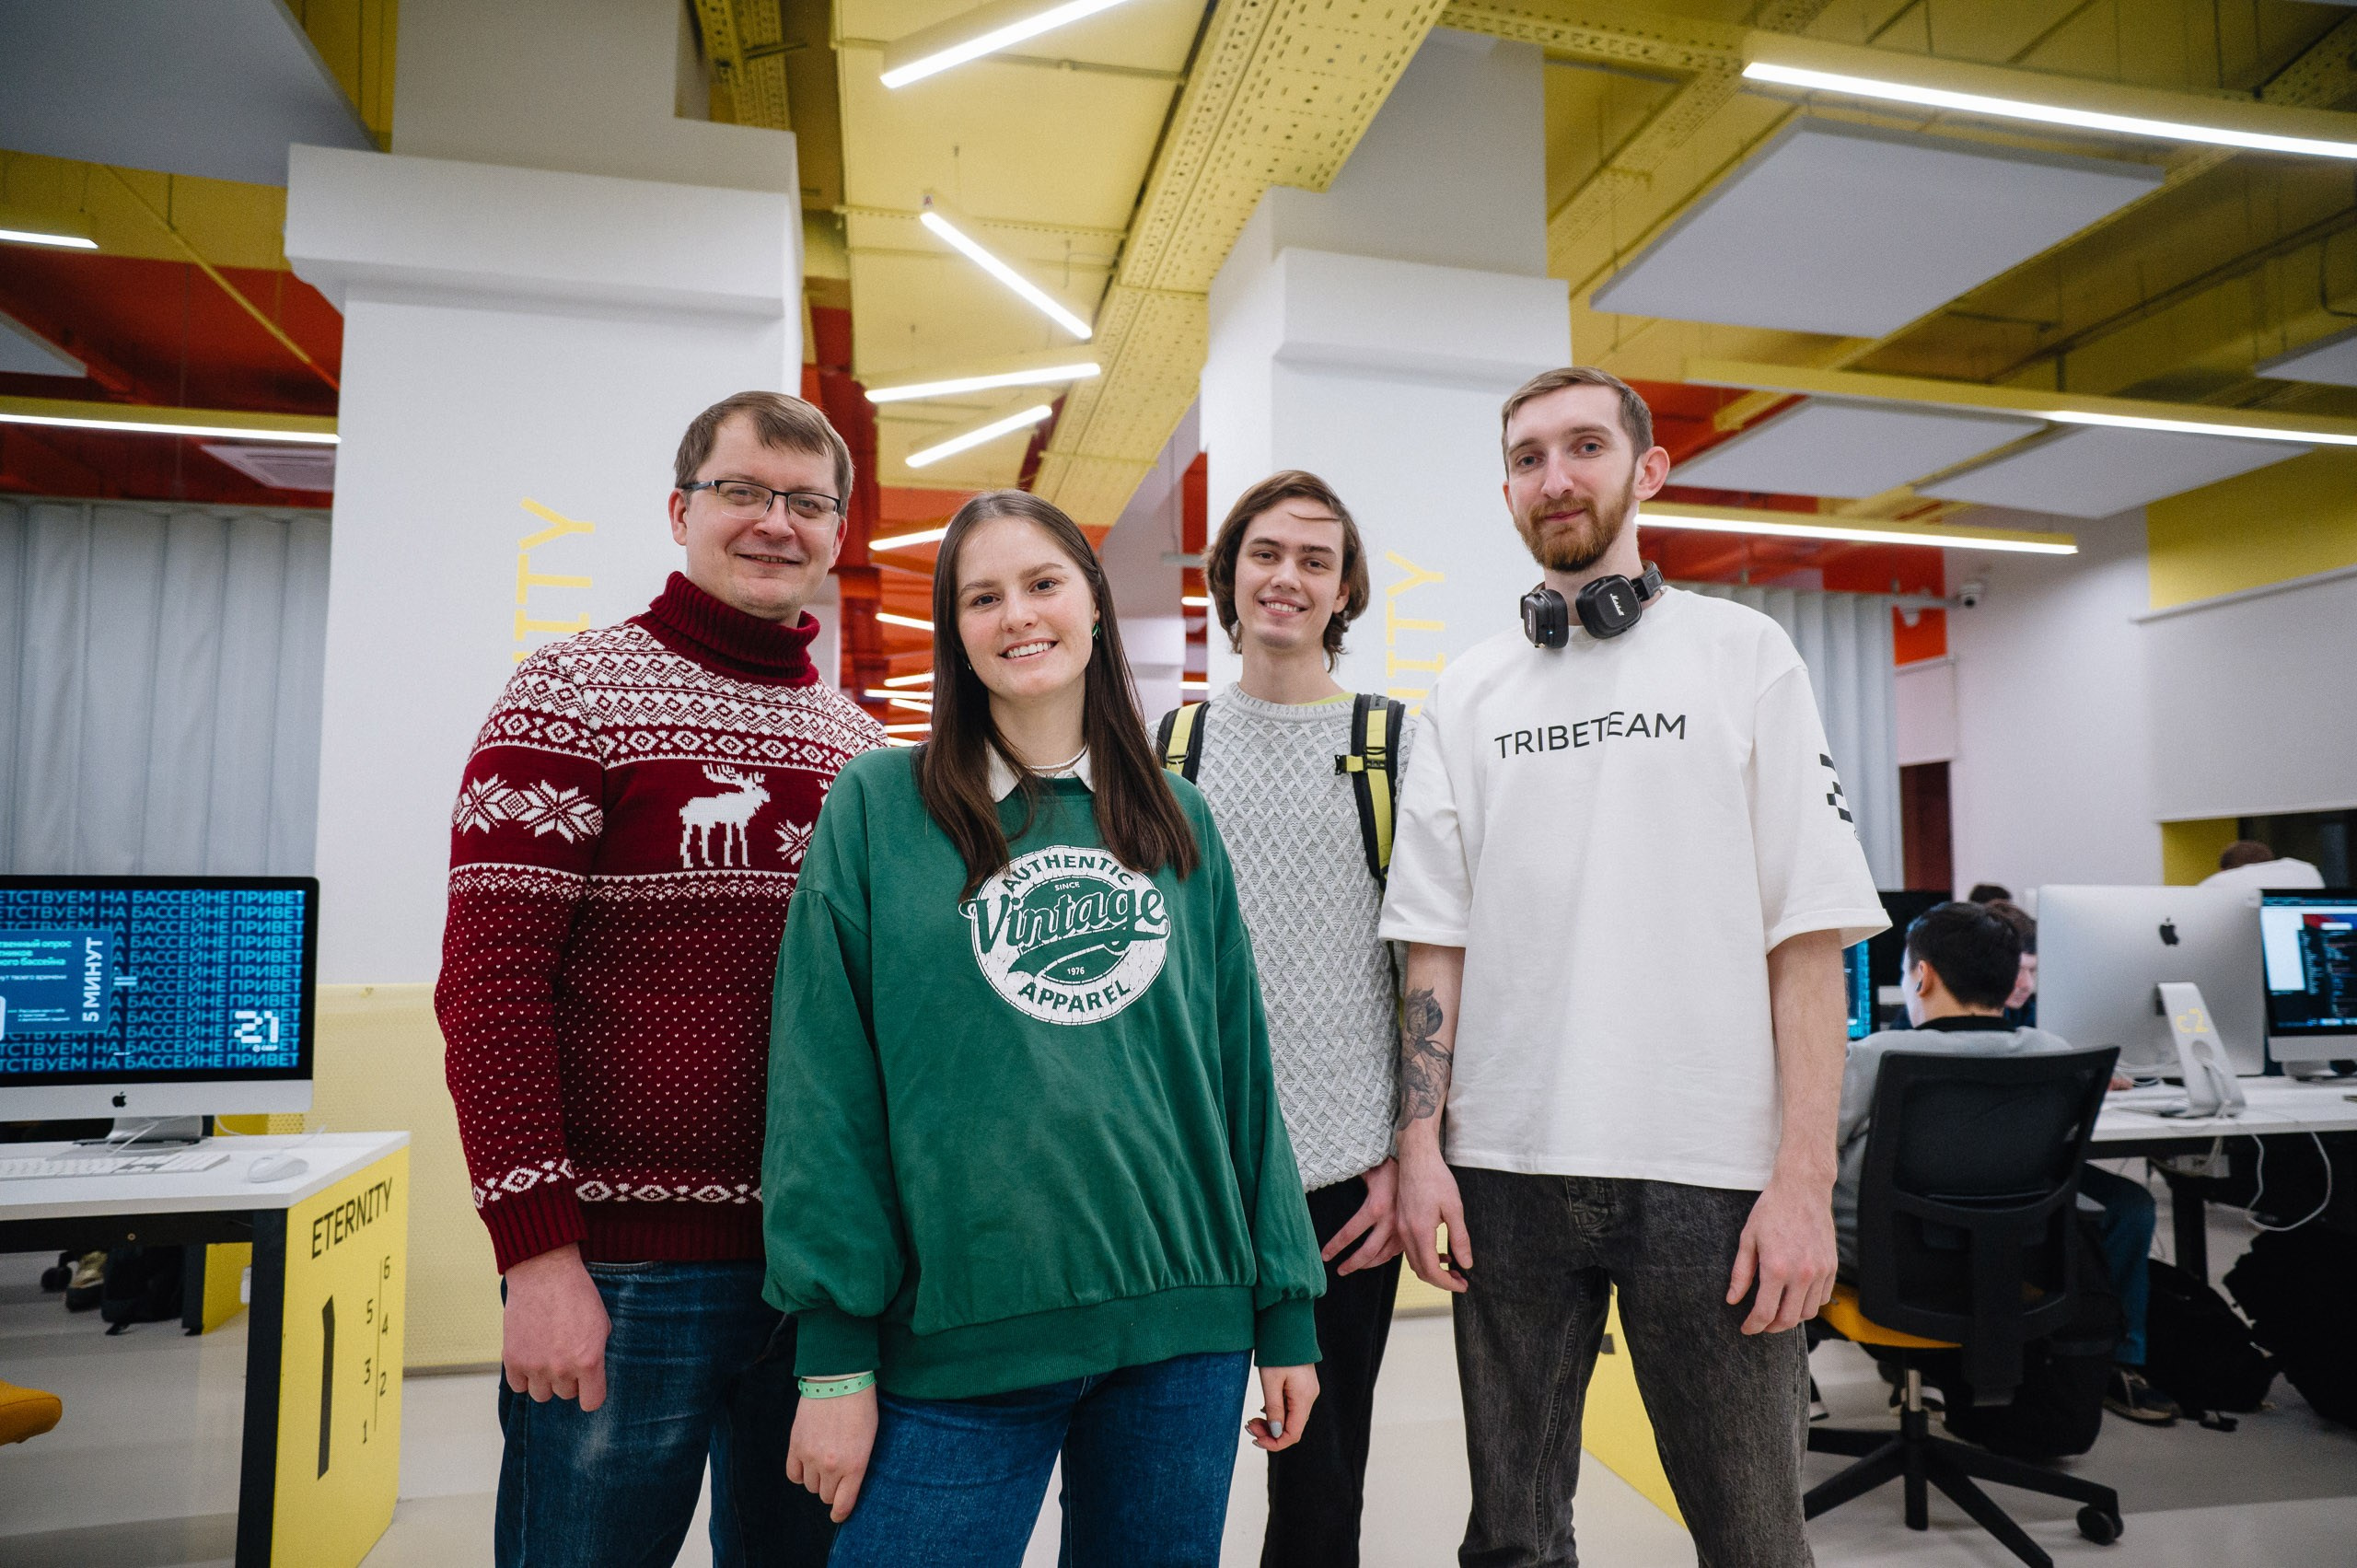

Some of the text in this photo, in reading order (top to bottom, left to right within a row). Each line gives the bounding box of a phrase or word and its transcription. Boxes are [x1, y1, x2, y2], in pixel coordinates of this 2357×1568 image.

[512, 496, 596, 663] ITY
[1494, 711, 1687, 760] TRIBETEAM
[1001, 854, 1135, 893] AUTHENTIC
[133, 889, 229, 903] БАССЕЙНЕ
[234, 890, 304, 903] ПРИВЕТ
[1054, 881, 1081, 891] SINCE
[132, 903, 228, 919] БАССЕЙНЕ
[233, 905, 303, 918] ПРИВЕТ
[131, 919, 228, 934] БАССЕЙНЕ
[232, 920, 303, 933] ПРИВЕТ
[958, 888, 1170, 955] Vintage
[130, 934, 227, 948] БАССЕЙНЕ
[232, 935, 302, 948] ПРИВЕТ
[130, 948, 227, 964] БАССЕЙНЕ
[231, 950, 302, 963] ПРИВЕТ
[82, 936, 103, 1023] 5 МИНУТ
[129, 963, 226, 979] БАССЕЙНЕ
[231, 965, 301, 978] ПРИВЕТ
[1067, 966, 1086, 976] 1976
[230, 980, 301, 993] ПРИВЕТ
[1017, 979, 1132, 1013] APPAREL
[127, 993, 226, 1009] БАССЕЙНЕ
[229, 994, 300, 1007] ПРИВЕТ
[127, 1008, 226, 1025] БАССЕЙНЕ
[126, 1023, 225, 1040] БАССЕЙНЕ
[234, 1011, 279, 1044] 21
[125, 1038, 225, 1054] БАССЕЙНЕ
[125, 1052, 224, 1070] БАССЕЙНЕ
[227, 1053, 298, 1066] ПРИВЕТ
[311, 1176, 393, 1260] ETERNITY
[383, 1255, 391, 1280] 6
[366, 1298, 374, 1324] 5
[381, 1312, 389, 1335] 4
[364, 1357, 371, 1385] 3
[379, 1371, 387, 1398] 2
[362, 1418, 367, 1445] 1
